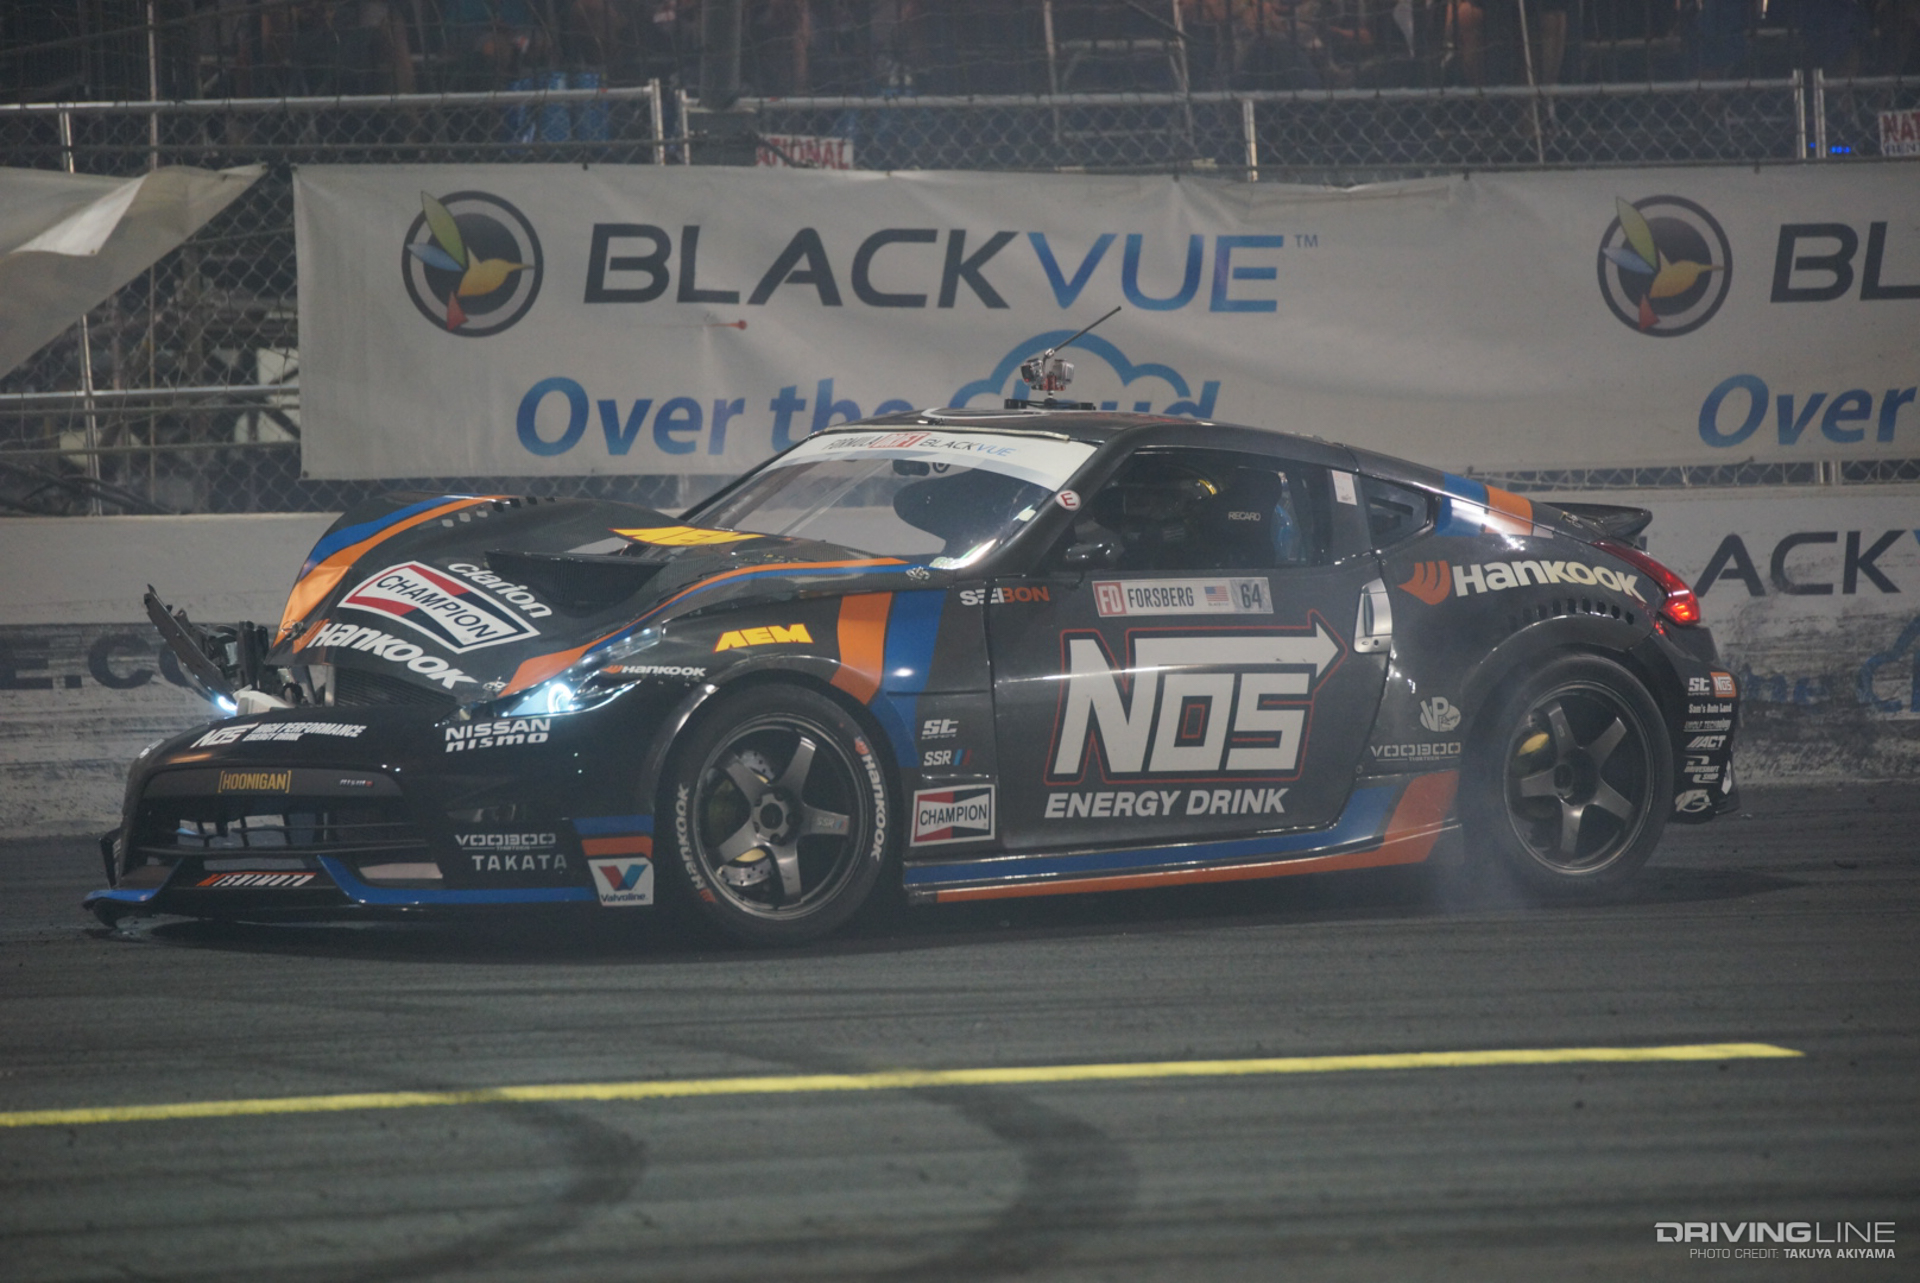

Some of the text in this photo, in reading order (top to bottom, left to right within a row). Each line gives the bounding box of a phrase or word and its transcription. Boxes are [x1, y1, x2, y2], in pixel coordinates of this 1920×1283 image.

[584, 223, 1284, 312] BLACKVUE
[516, 376, 746, 457] Over
[1698, 373, 1918, 448] Over
[918, 437, 1018, 457] BLACKVUE
[376, 575, 498, 639] CHAMPION
[1127, 586, 1195, 608] FORSBERG
[1240, 583, 1263, 608] 64
[714, 624, 813, 652] AEM
[1053, 627, 1332, 774] NOS
[189, 722, 262, 749] NOS
[279, 722, 367, 738] PERFORMANCE
[446, 719, 550, 740] NISSAN
[924, 751, 952, 766] SSR
[919, 804, 987, 825] CHAMPION
[1044, 788, 1289, 818] ENERGY DRINK
[472, 854, 567, 871] TAKATA
[600, 892, 647, 903] Valvoline
